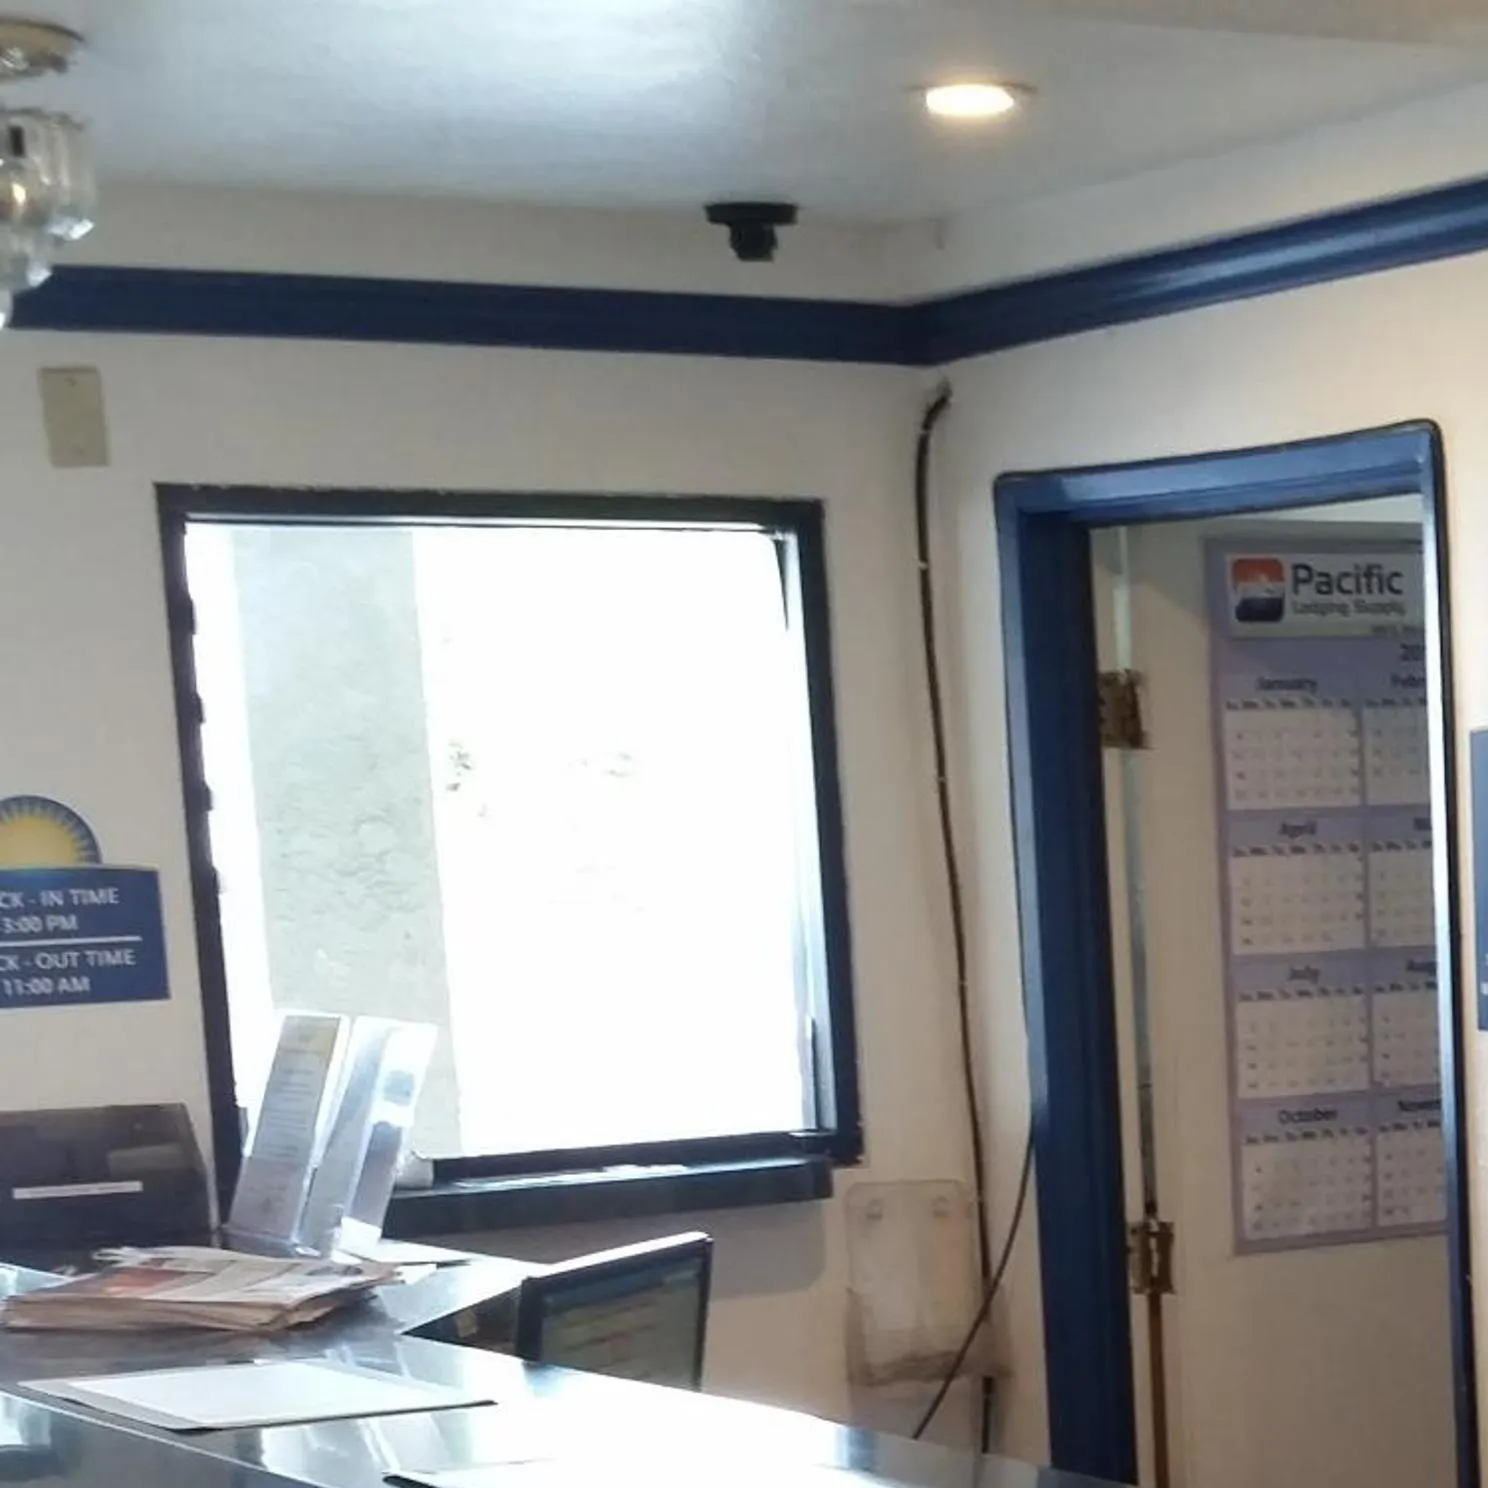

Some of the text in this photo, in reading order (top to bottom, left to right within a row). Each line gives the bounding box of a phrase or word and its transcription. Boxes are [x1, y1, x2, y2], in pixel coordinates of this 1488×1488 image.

[1290, 562, 1405, 596] Pacific
[40, 889, 64, 907] IN
[69, 887, 120, 906] TIME
[46, 914, 78, 932] PM
[35, 951, 80, 970] OUT
[86, 949, 137, 968] TIME
[57, 976, 91, 994] AM
